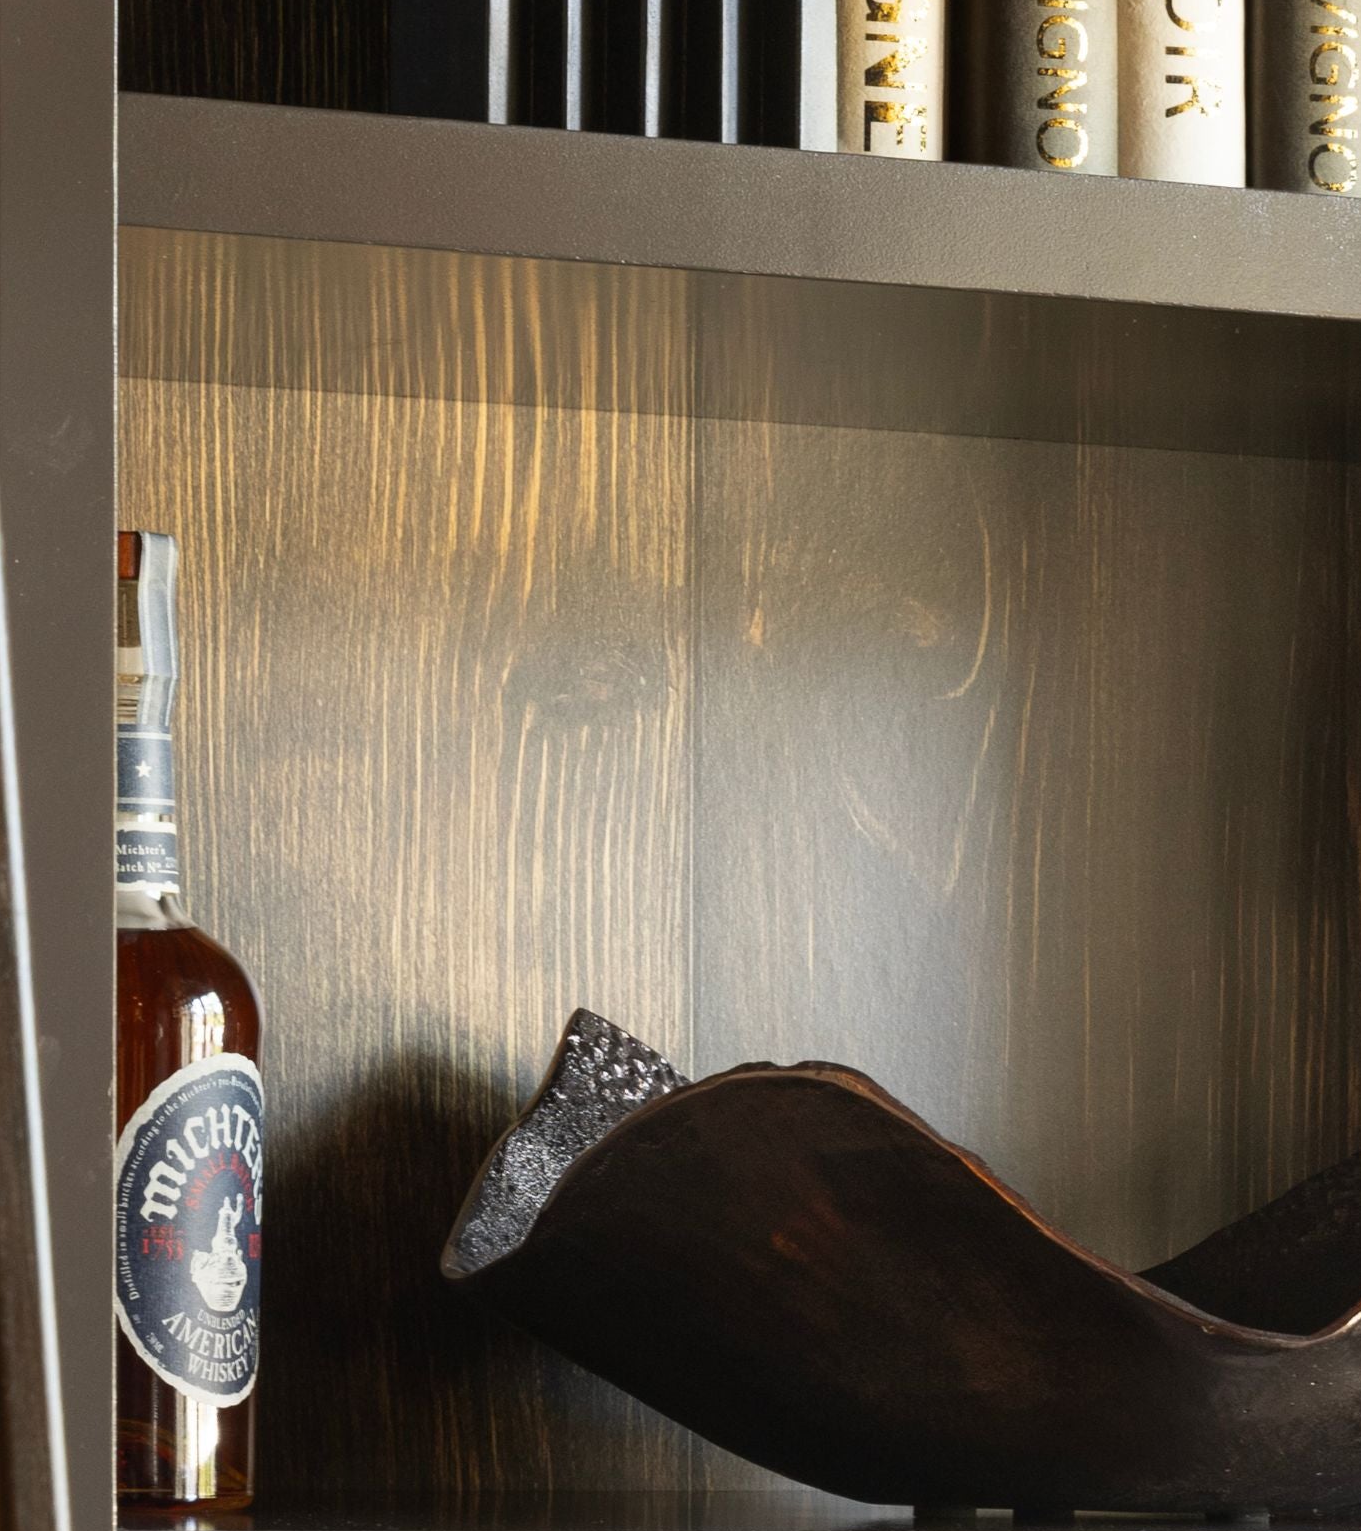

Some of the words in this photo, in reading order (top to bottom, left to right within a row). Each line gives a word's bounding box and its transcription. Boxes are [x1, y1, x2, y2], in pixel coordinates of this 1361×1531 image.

[156, 1115, 166, 1127] to
[163, 1102, 180, 1118] the
[130, 1125, 161, 1170] according
[118, 1171, 136, 1209] batches
[185, 1152, 227, 1211] SMALL
[117, 1213, 128, 1240] small
[120, 1255, 141, 1301] Distilled
[161, 1308, 259, 1360] AMERICAN
[188, 1353, 251, 1384] WHISKEY
